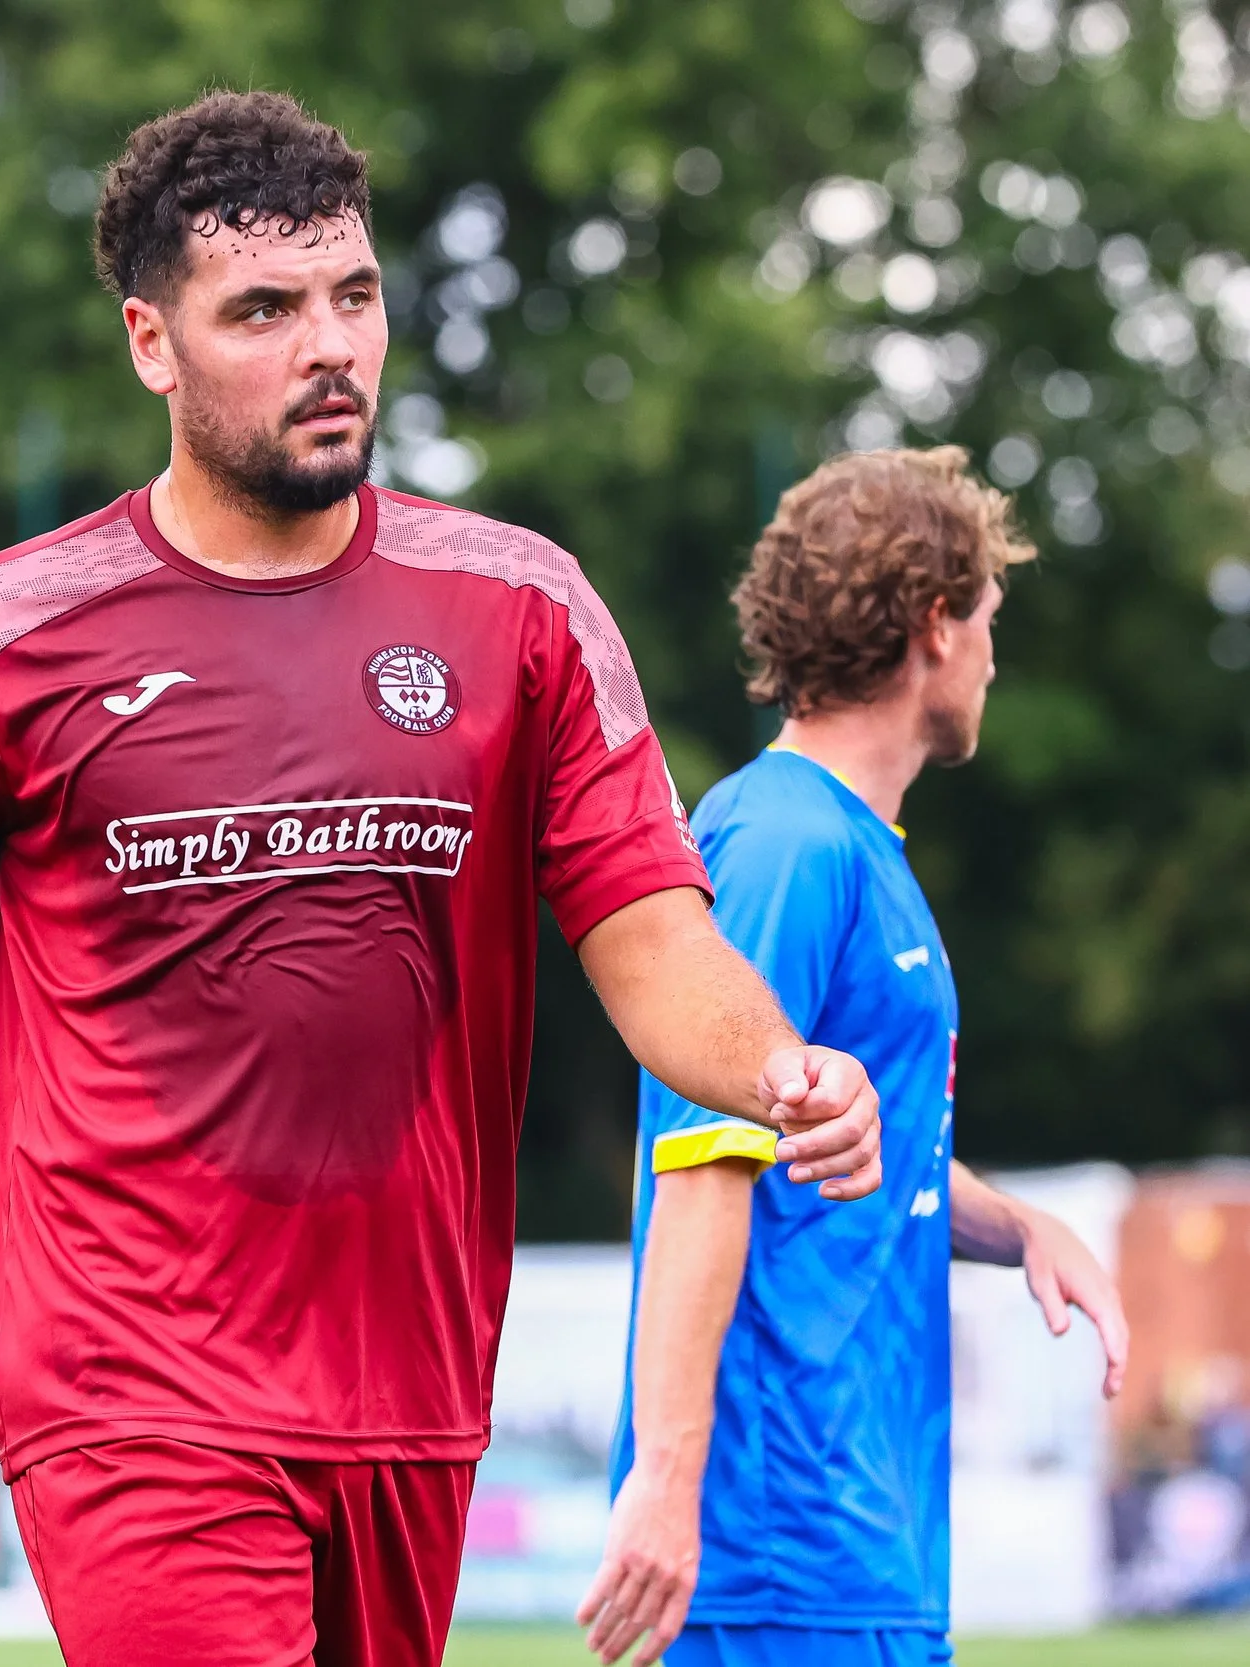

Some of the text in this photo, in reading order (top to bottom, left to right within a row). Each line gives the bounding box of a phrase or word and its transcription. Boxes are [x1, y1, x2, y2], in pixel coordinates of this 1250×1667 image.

[368, 646, 449, 674] NUNEATON TOWN
[378, 703, 455, 731] FOOTBALL CLUB
[105, 816, 250, 876] Simply
